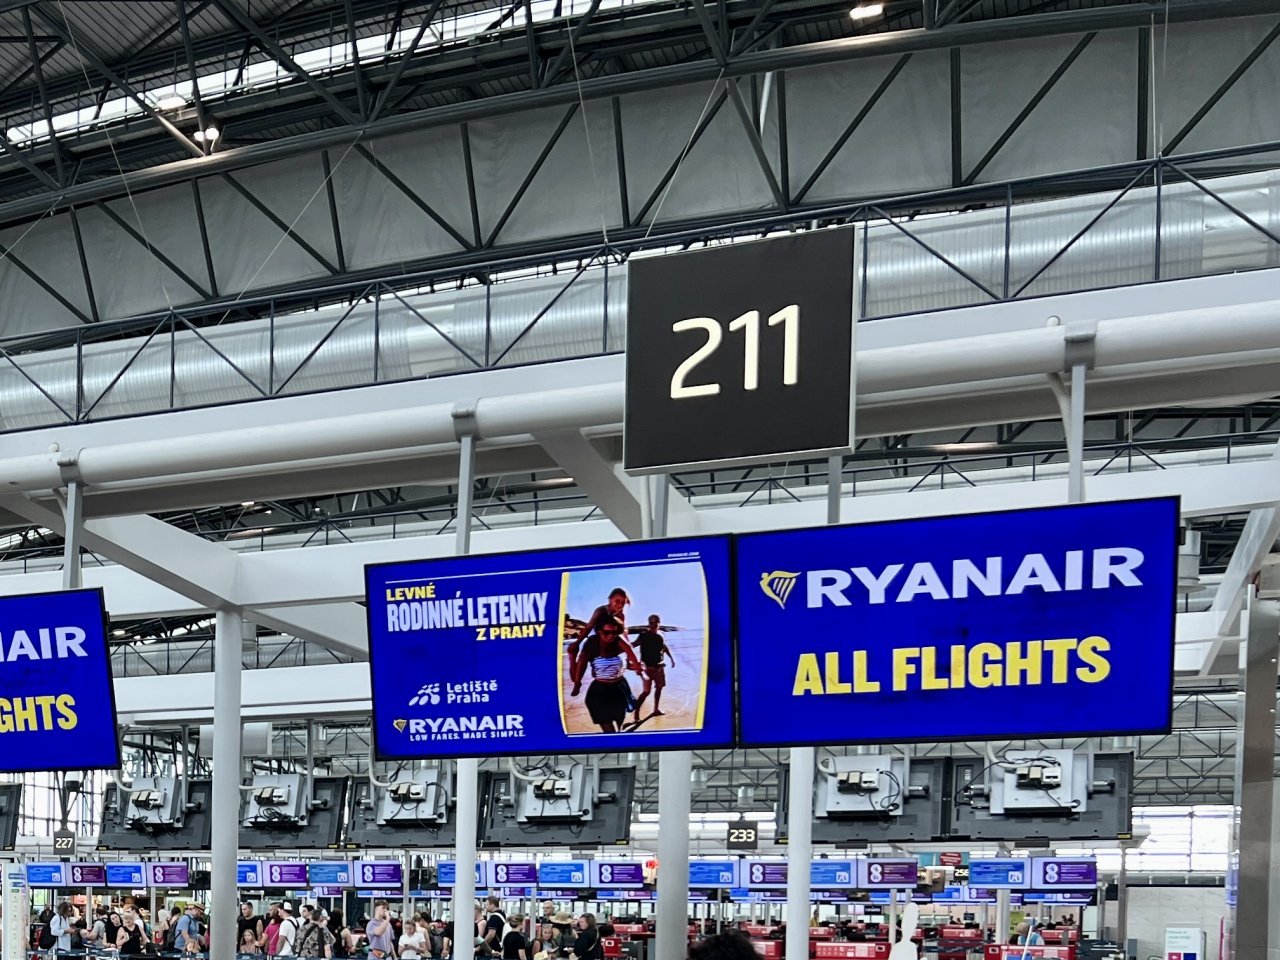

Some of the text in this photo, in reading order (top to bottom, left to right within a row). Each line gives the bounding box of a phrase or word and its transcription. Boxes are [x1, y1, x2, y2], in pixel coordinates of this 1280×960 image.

[670, 304, 800, 399] 211
[806, 547, 1144, 608] RYANAIR
[386, 582, 436, 601] LEVNÉ
[387, 591, 548, 632] RODINNÉ LETENKY
[476, 624, 546, 641] Z PRAHY
[792, 636, 1111, 696] ALL FLIGHTS
[447, 679, 498, 693] Letiště
[447, 692, 490, 704] Praha
[409, 714, 524, 733] RYANAIR
[463, 731, 487, 739] MADE
[55, 838, 74, 849] 227
[729, 828, 756, 843] 233
